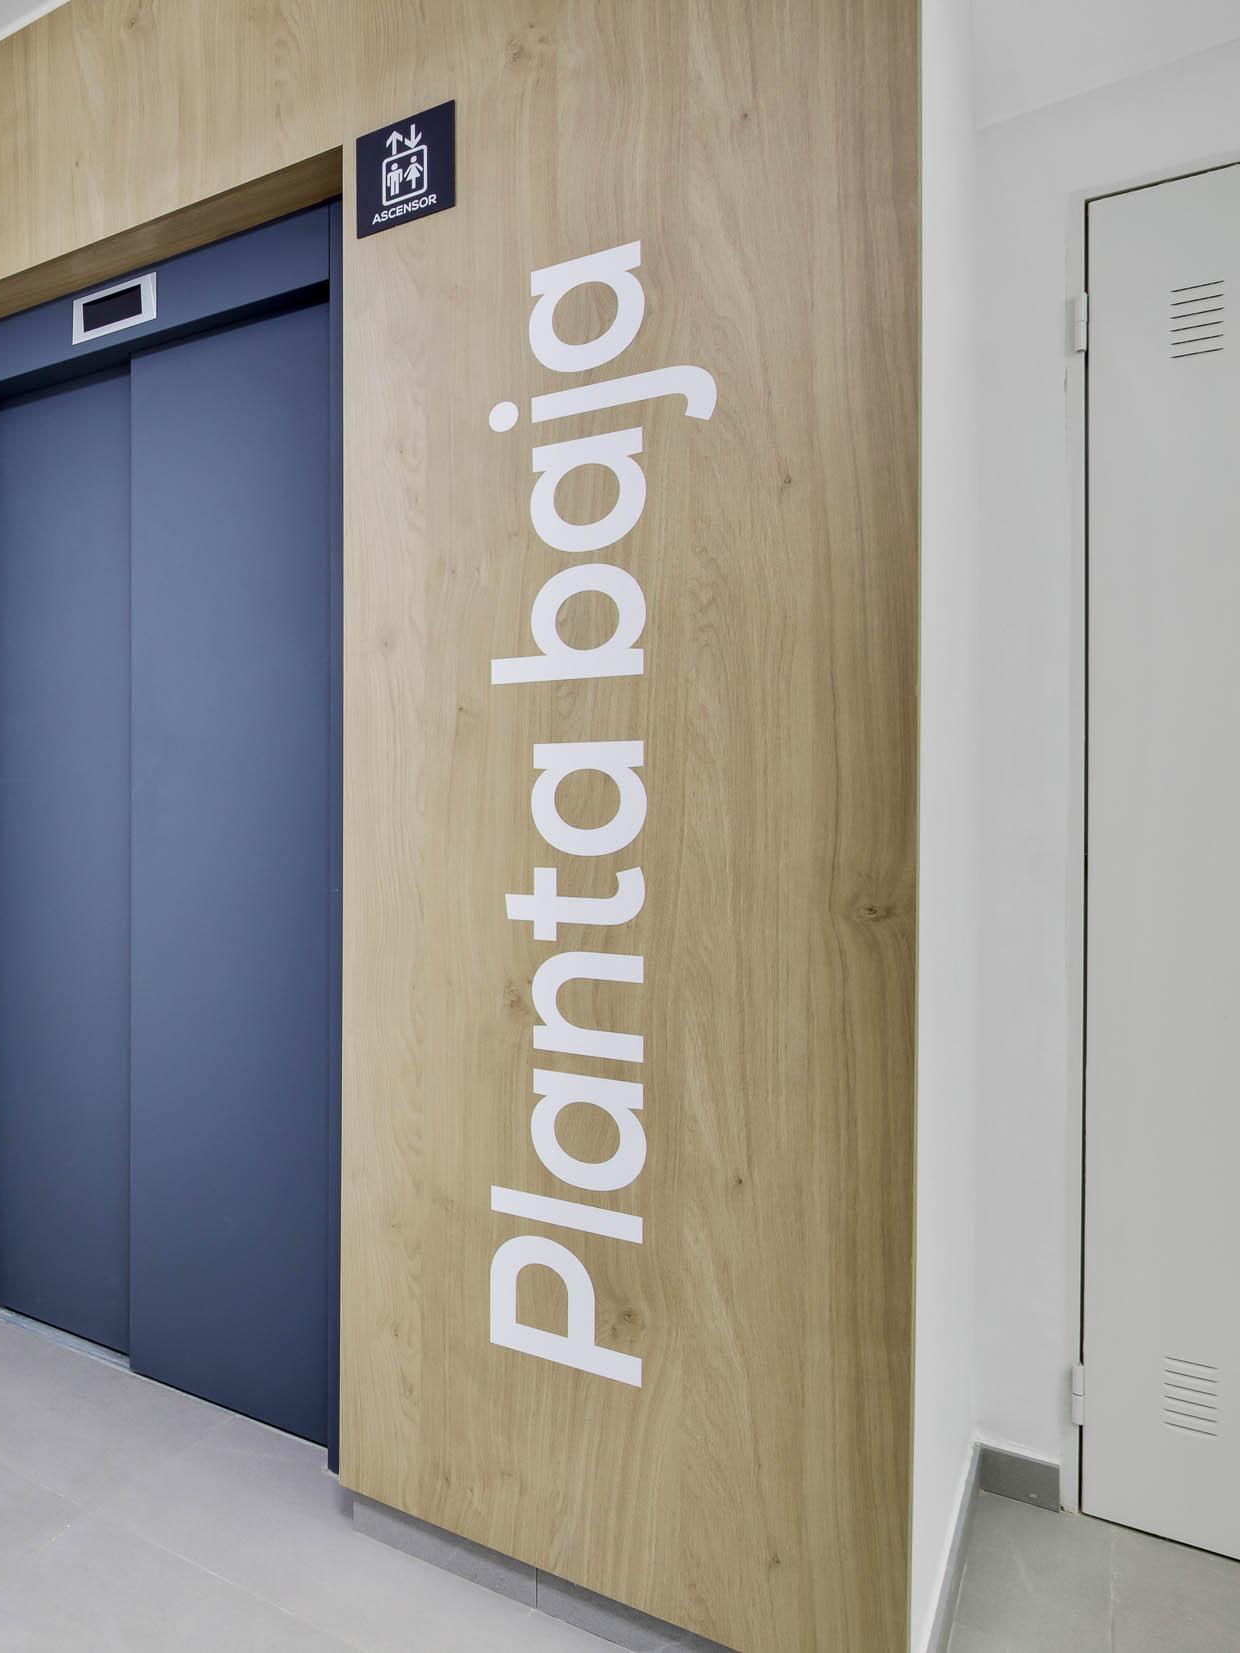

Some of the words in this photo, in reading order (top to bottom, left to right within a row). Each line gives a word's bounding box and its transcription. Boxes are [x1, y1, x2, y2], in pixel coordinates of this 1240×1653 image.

[372, 194, 437, 225] ASCENSOR
[489, 240, 717, 684] baja
[490, 741, 647, 1387] Planta
